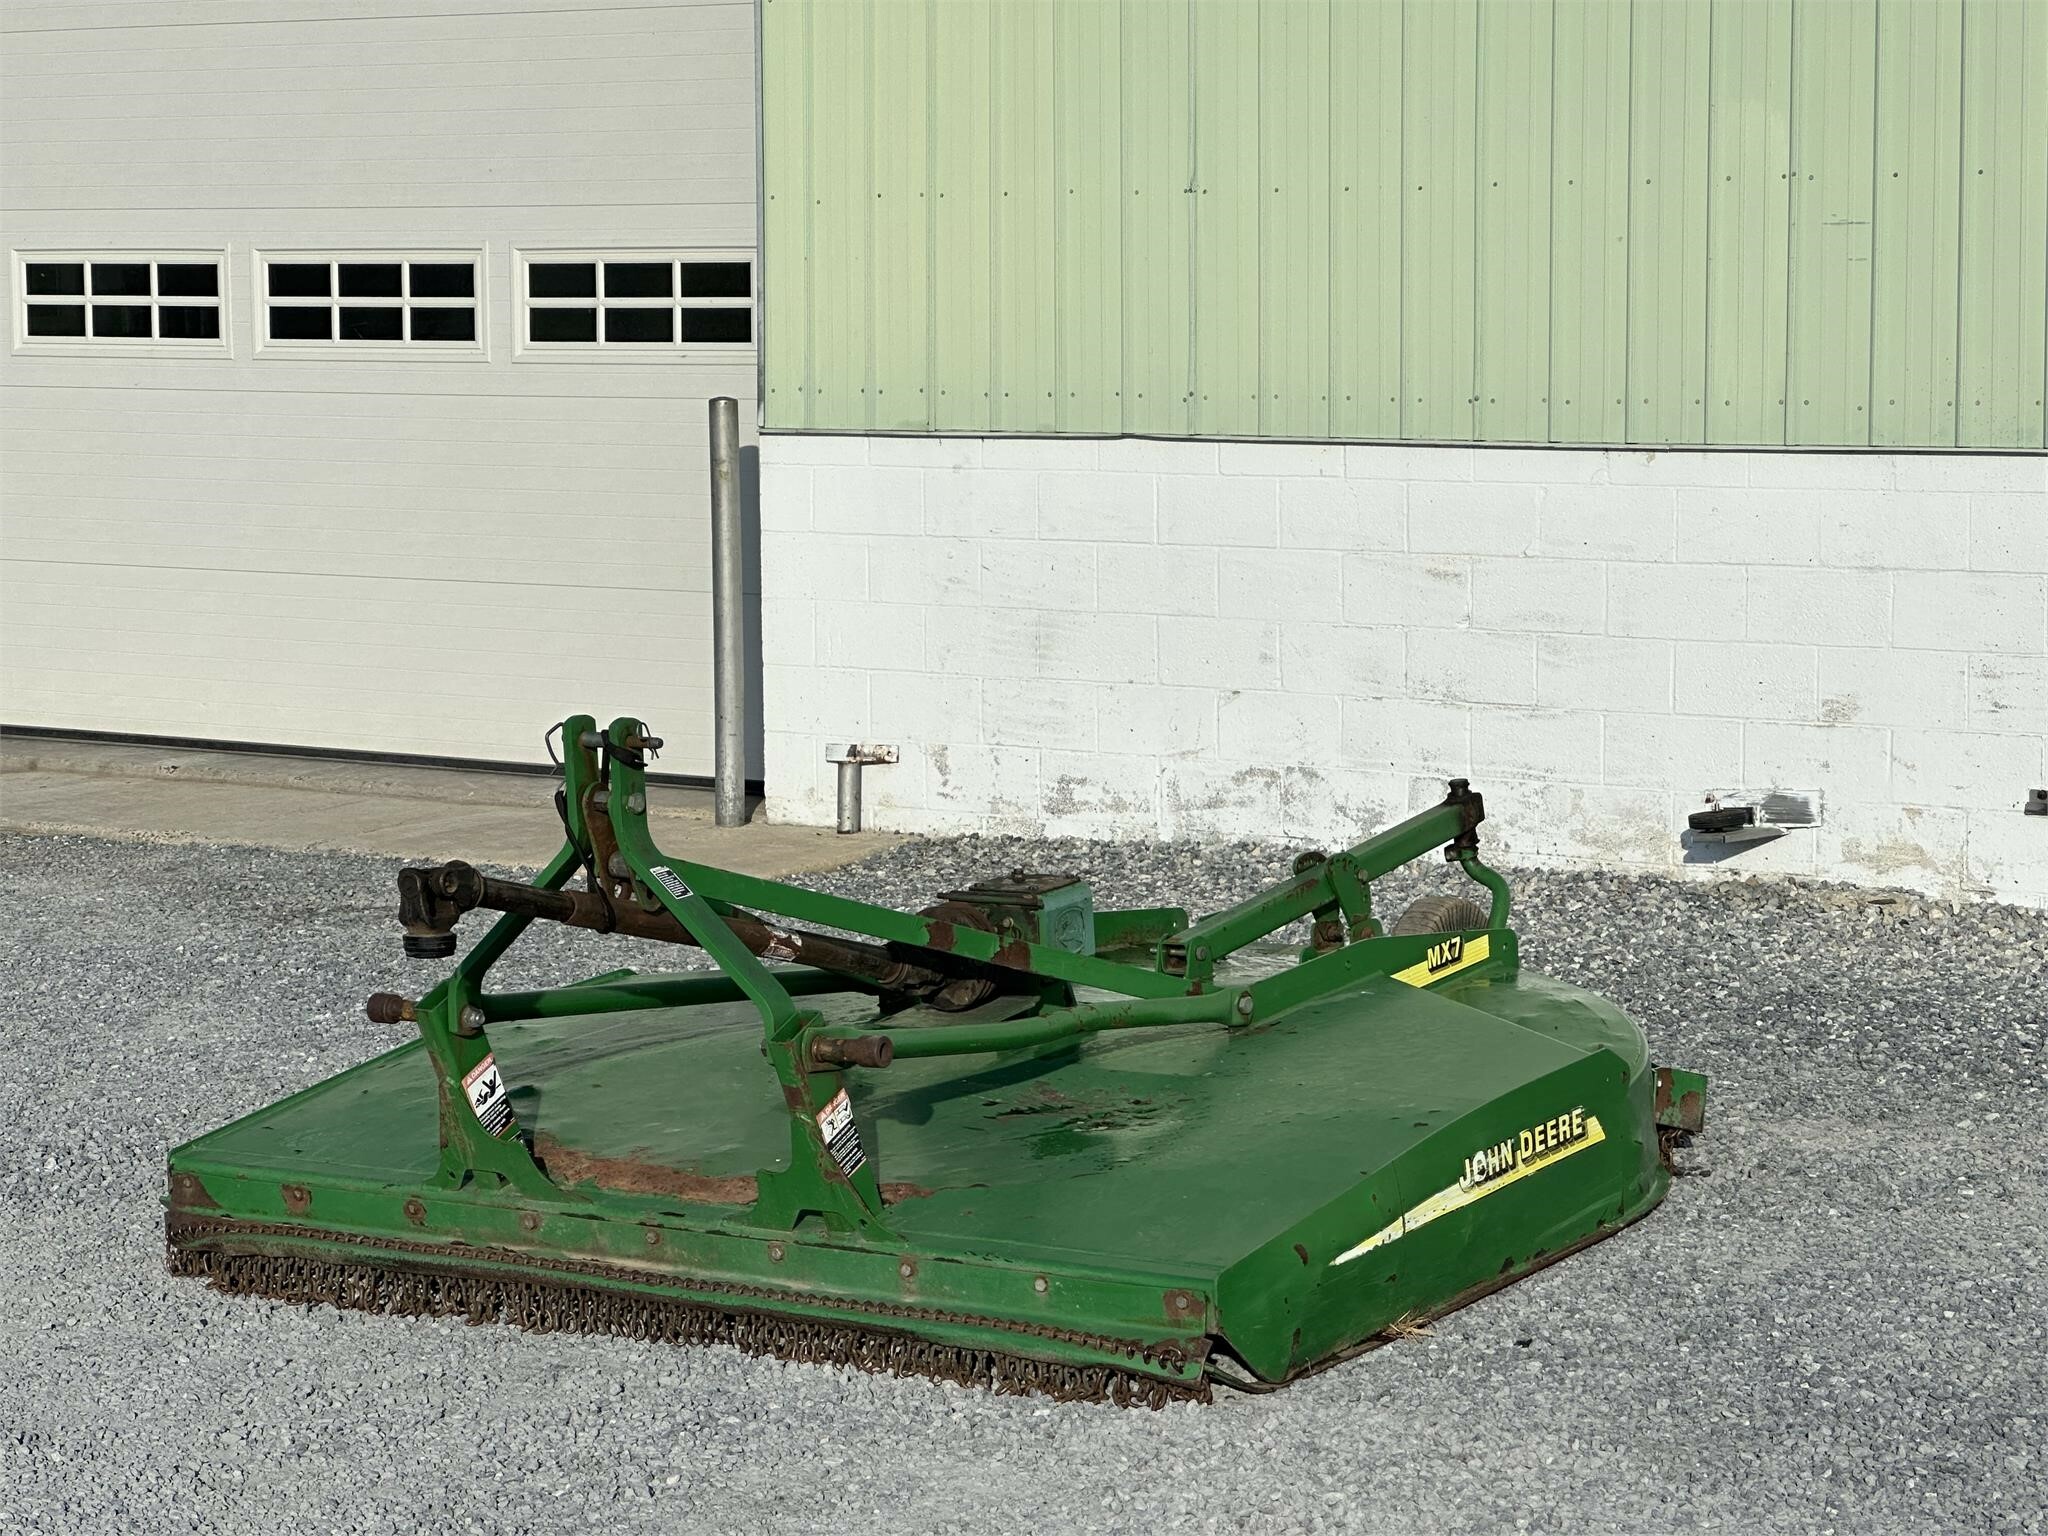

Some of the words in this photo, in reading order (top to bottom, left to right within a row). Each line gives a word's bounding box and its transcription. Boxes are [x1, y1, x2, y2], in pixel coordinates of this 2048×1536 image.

[1427, 935, 1462, 971] MX7
[1459, 1138, 1515, 1189] JOHN
[1519, 1107, 1584, 1161] DEERE
